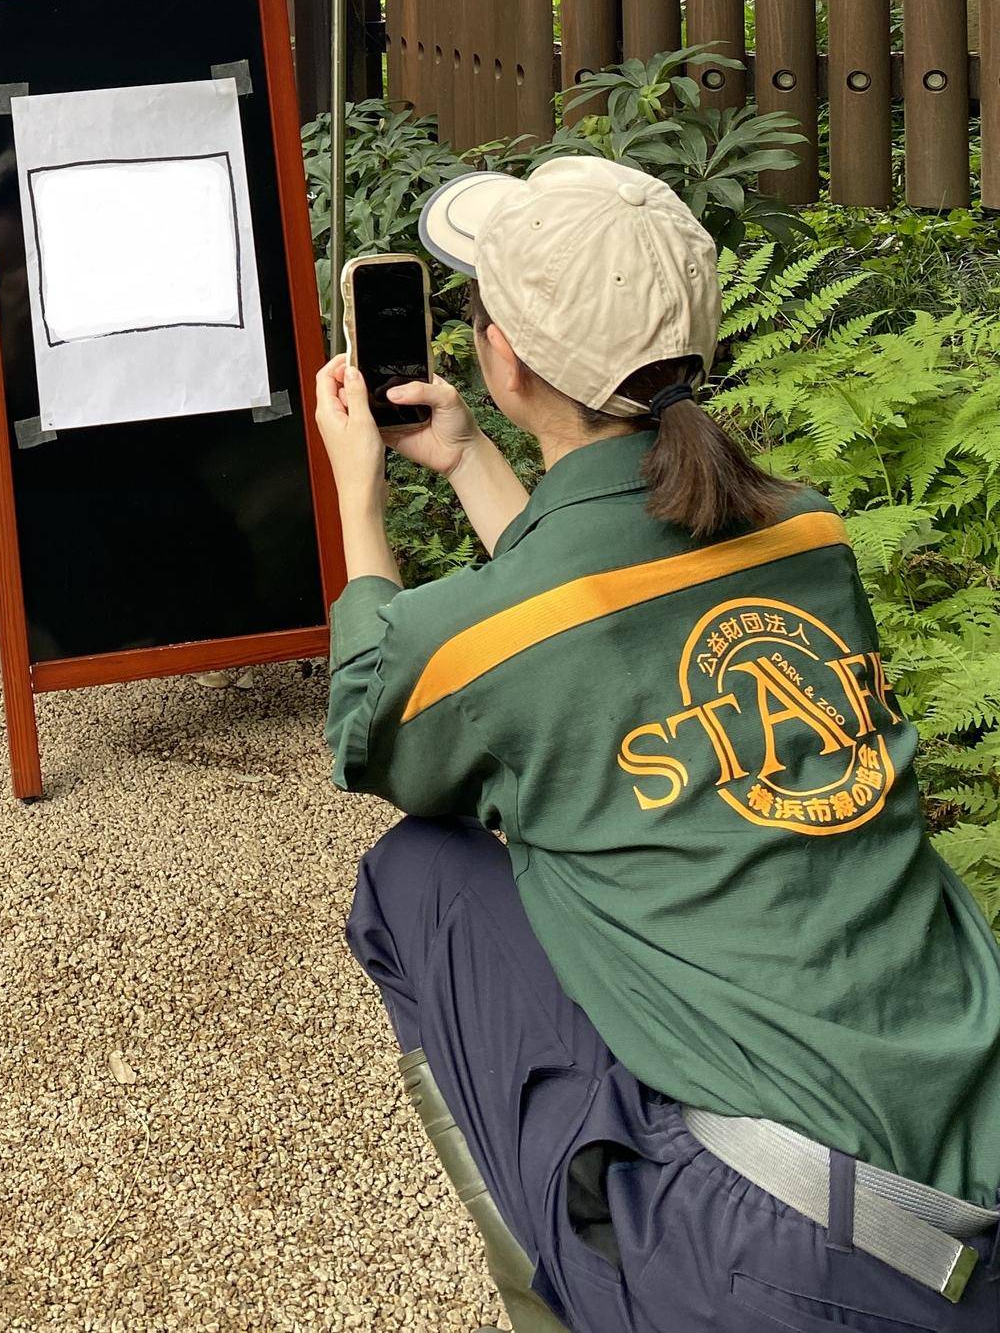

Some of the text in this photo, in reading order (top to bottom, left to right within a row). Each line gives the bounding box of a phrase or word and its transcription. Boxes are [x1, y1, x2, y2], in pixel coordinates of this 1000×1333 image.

[696, 612, 811, 678] 公益財団法人
[771, 652, 845, 726] PARK & ZOO
